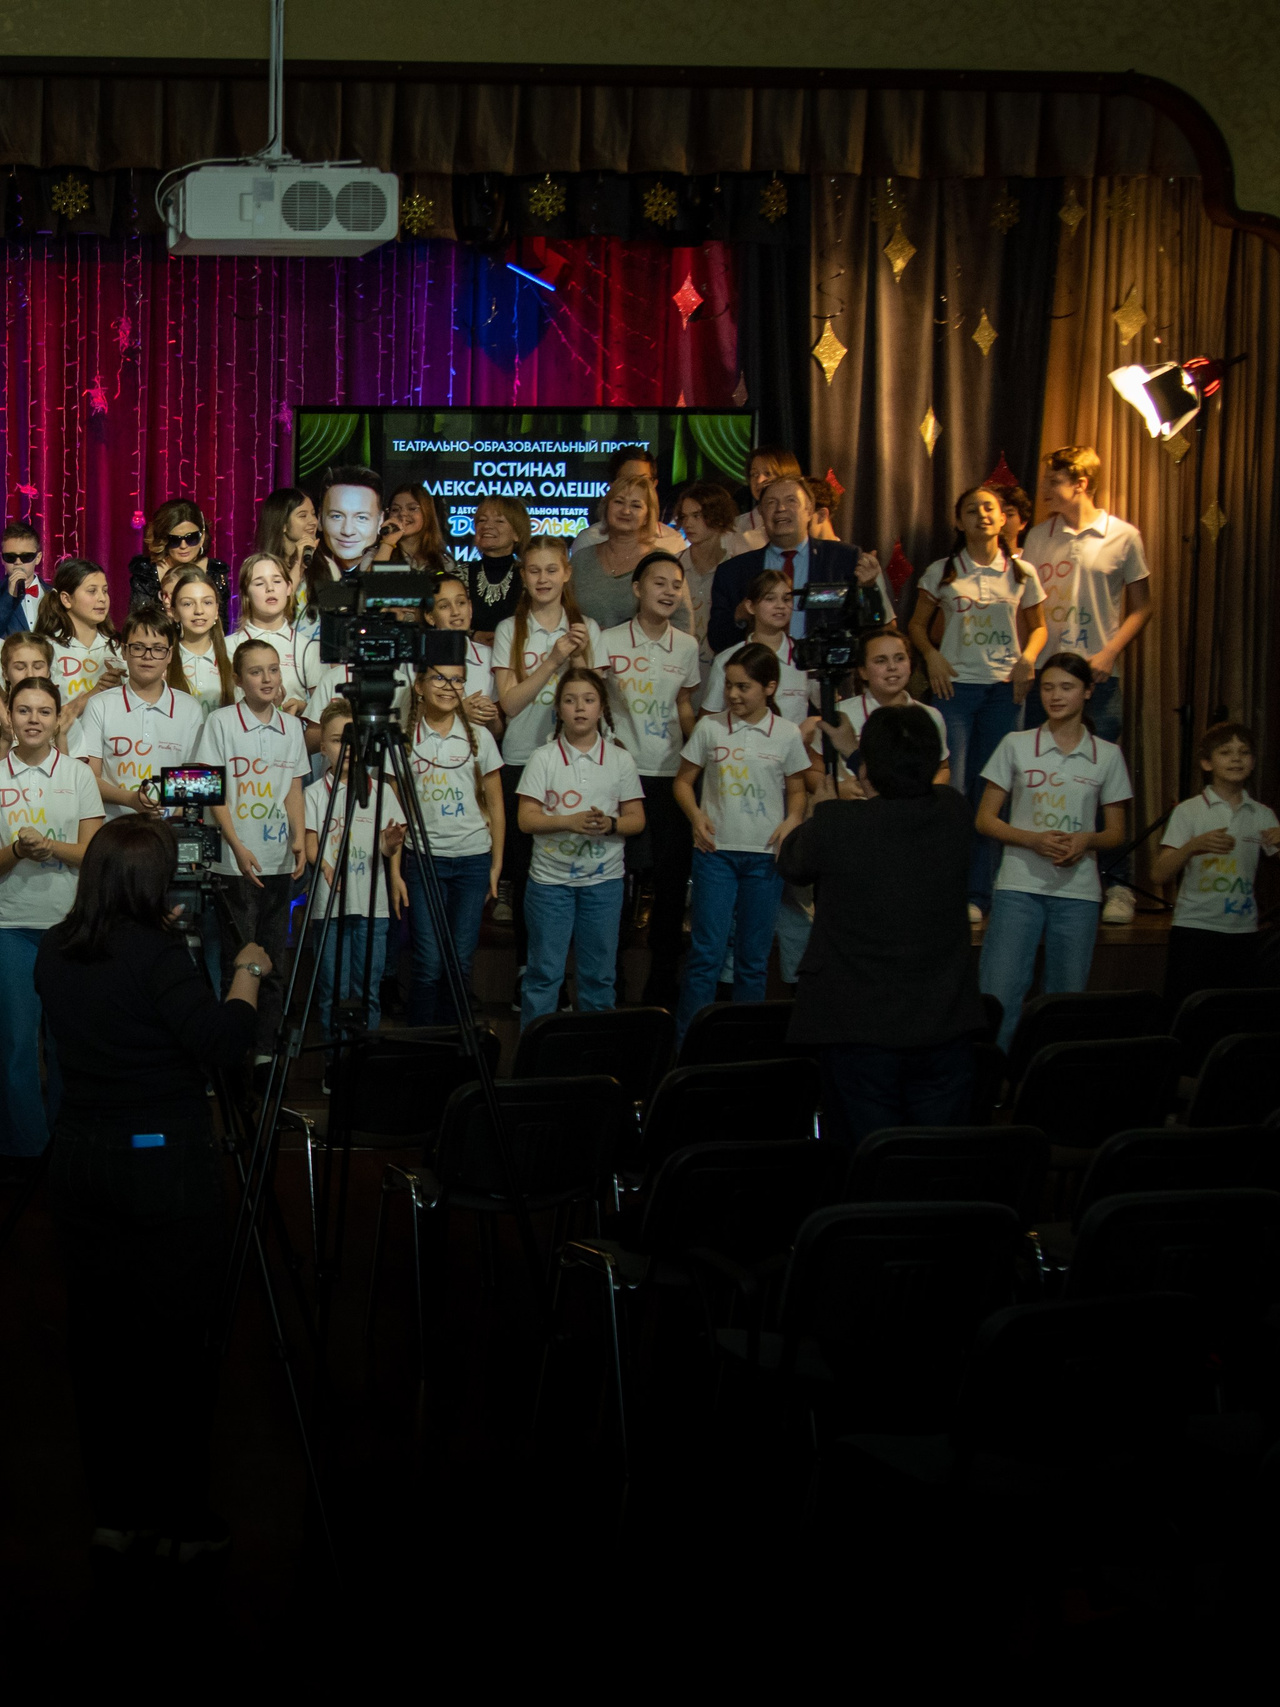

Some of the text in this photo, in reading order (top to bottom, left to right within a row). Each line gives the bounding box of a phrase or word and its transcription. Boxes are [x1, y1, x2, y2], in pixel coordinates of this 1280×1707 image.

[392, 440, 598, 453] ТЕАТРАЛЬНО-ОБРАЗОВАТЕЛЬНЫЙ
[473, 461, 566, 478] ГОСТИНАЯ
[539, 480, 611, 498] ОЛЕШК
[450, 506, 457, 514] В
[560, 507, 589, 516] ТЕАТРЕ
